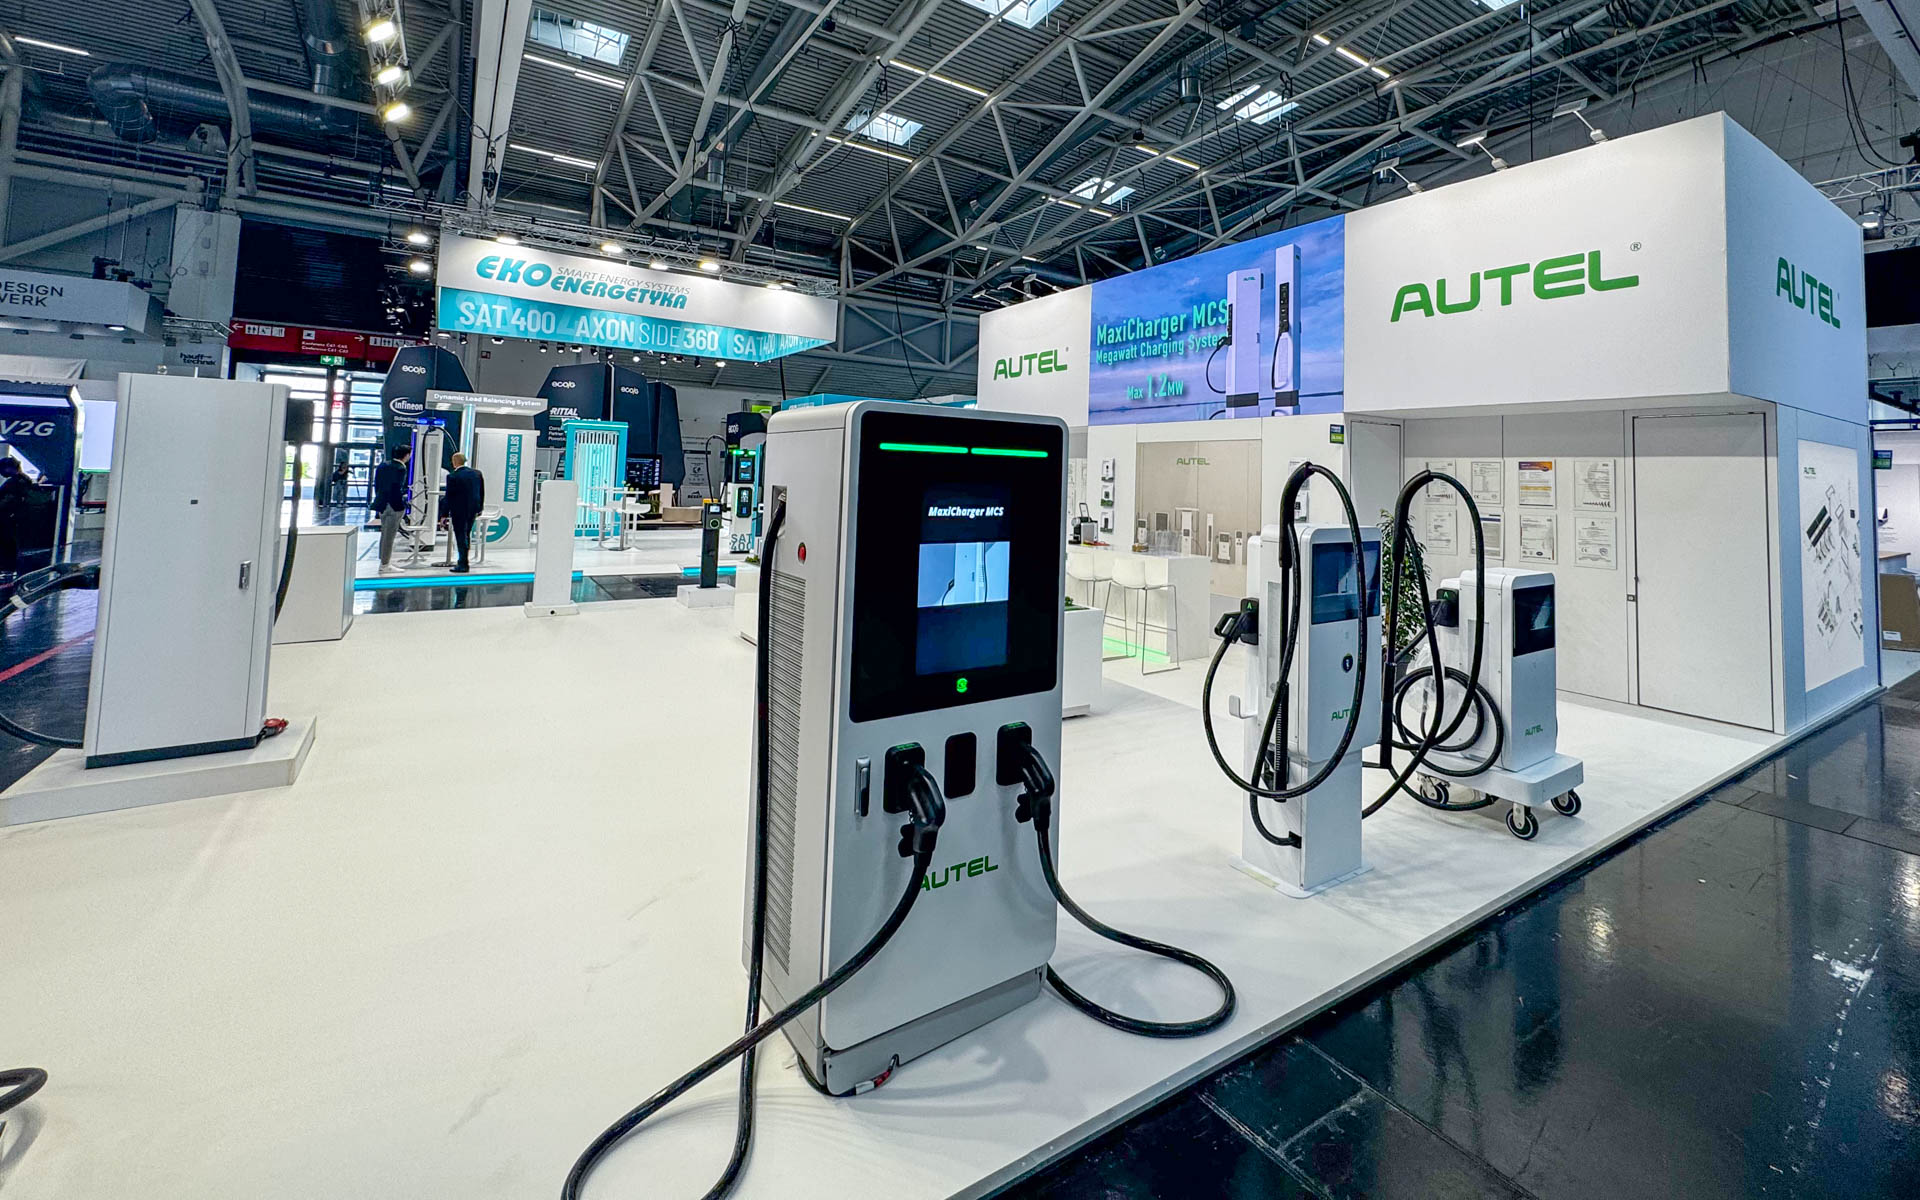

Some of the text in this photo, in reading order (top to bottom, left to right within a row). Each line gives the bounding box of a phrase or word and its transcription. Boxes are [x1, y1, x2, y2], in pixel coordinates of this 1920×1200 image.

[476, 255, 552, 287] EKO
[0, 280, 64, 297] ESIGN
[556, 266, 692, 295] SMART ENERGY SYSTEMS
[1390, 250, 1639, 322] AUTEL
[550, 275, 689, 309] ENERGETYKA
[1776, 256, 1840, 329] AUTEL
[459, 302, 507, 328] SAT
[511, 309, 555, 335] 400
[575, 315, 634, 343] AXON
[639, 323, 680, 347] SIDE
[683, 327, 719, 352] 360
[1096, 298, 1228, 347] MaxiCharger MCS
[1096, 344, 1138, 365] Megawatt
[1140, 338, 1185, 358] Charging
[993, 348, 1068, 381] AUTEL
[434, 393, 464, 402] Dynamic
[483, 397, 516, 406] Balancing
[517, 399, 541, 407] System
[1127, 385, 1144, 400] Max
[550, 407, 578, 416] RITTAL
[0, 420, 56, 436] V2G
[509, 454, 519, 466] 360
[1176, 457, 1211, 465] AUTEL
[508, 467, 518, 482] SIDE
[507, 482, 517, 500] AXON
[928, 505, 1004, 519] MaxiCharger MCS
[730, 533, 752, 543] SAT
[1331, 708, 1351, 721] AUT
[1525, 724, 1544, 736] AUTEL
